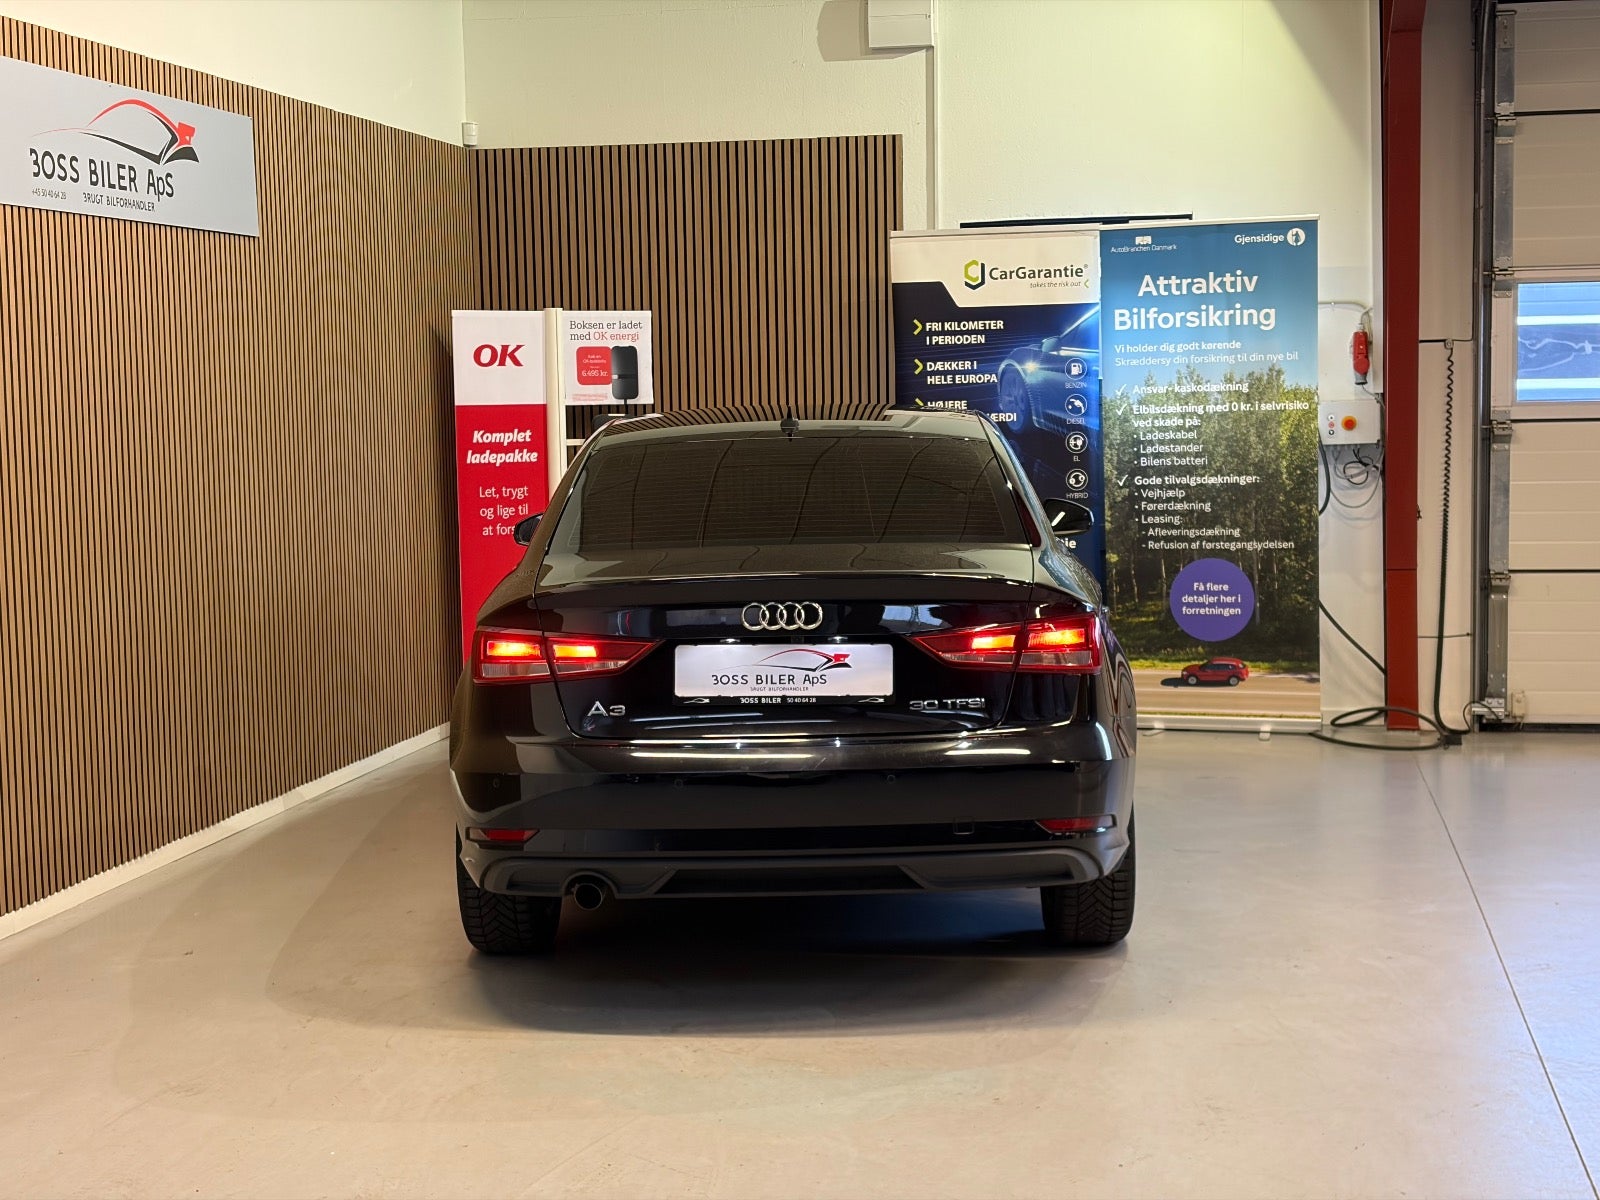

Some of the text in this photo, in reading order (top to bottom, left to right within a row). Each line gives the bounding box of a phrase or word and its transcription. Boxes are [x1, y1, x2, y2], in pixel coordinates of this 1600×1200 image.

[88, 158, 138, 192] BILER
[146, 168, 174, 202] ApS
[106, 196, 155, 212] BILFORHANDLER
[1234, 234, 1284, 244] Gjensidige
[989, 264, 1084, 281] CarGarantie
[1138, 270, 1258, 296] Attraktiv
[1114, 303, 1276, 331] Bilforsikring
[569, 321, 604, 329] Boksen
[619, 321, 642, 329] ladet
[926, 320, 1004, 331] FRI KILOMETER
[570, 332, 639, 342] med OK energi
[926, 335, 985, 345] I PERIODEN
[1114, 340, 1242, 353] Vi holder dig godt kørende
[473, 344, 525, 367] OK
[1114, 351, 1298, 367] Skræddersy din forsikring til din nye bil
[926, 361, 977, 371] DÆKKER I
[927, 375, 997, 384] HELE EUROPA
[1174, 382, 1249, 394] kaskodækning
[1133, 404, 1204, 415] Elbilsdækning
[1206, 402, 1228, 411] med
[1232, 402, 1238, 411] 0
[1240, 402, 1253, 411] kr.
[1261, 401, 1309, 410] selvrisiko
[987, 413, 1016, 422] ÆRDI
[1133, 417, 1201, 427] ved skade på:
[473, 428, 532, 446] Komplet
[1140, 430, 1197, 440] Ladeskabel
[1140, 444, 1203, 453] Ladestander
[467, 450, 538, 466] ladepakke
[1140, 456, 1208, 466] Bilens batteri
[1134, 474, 1260, 486] Gode tilvalgsdækninger:
[479, 486, 528, 499] Let, trygt
[1141, 489, 1185, 499] Vejhjælp
[480, 503, 529, 520] og lige til
[1141, 502, 1211, 512] Førerdækning
[1141, 515, 1183, 525] Leasing:
[482, 525, 493, 536] at
[1148, 527, 1240, 538] Afleveringsdækning
[1148, 540, 1294, 551] Refusion af førstegangsydelsen
[1194, 582, 1229, 591] Få flere
[1182, 595, 1218, 604] detaljer
[1182, 606, 1241, 616] forretningen
[755, 674, 795, 685] BILER
[803, 674, 827, 686] ApS
[587, 701, 626, 716] A3
[910, 698, 985, 710] 30 TFSI
